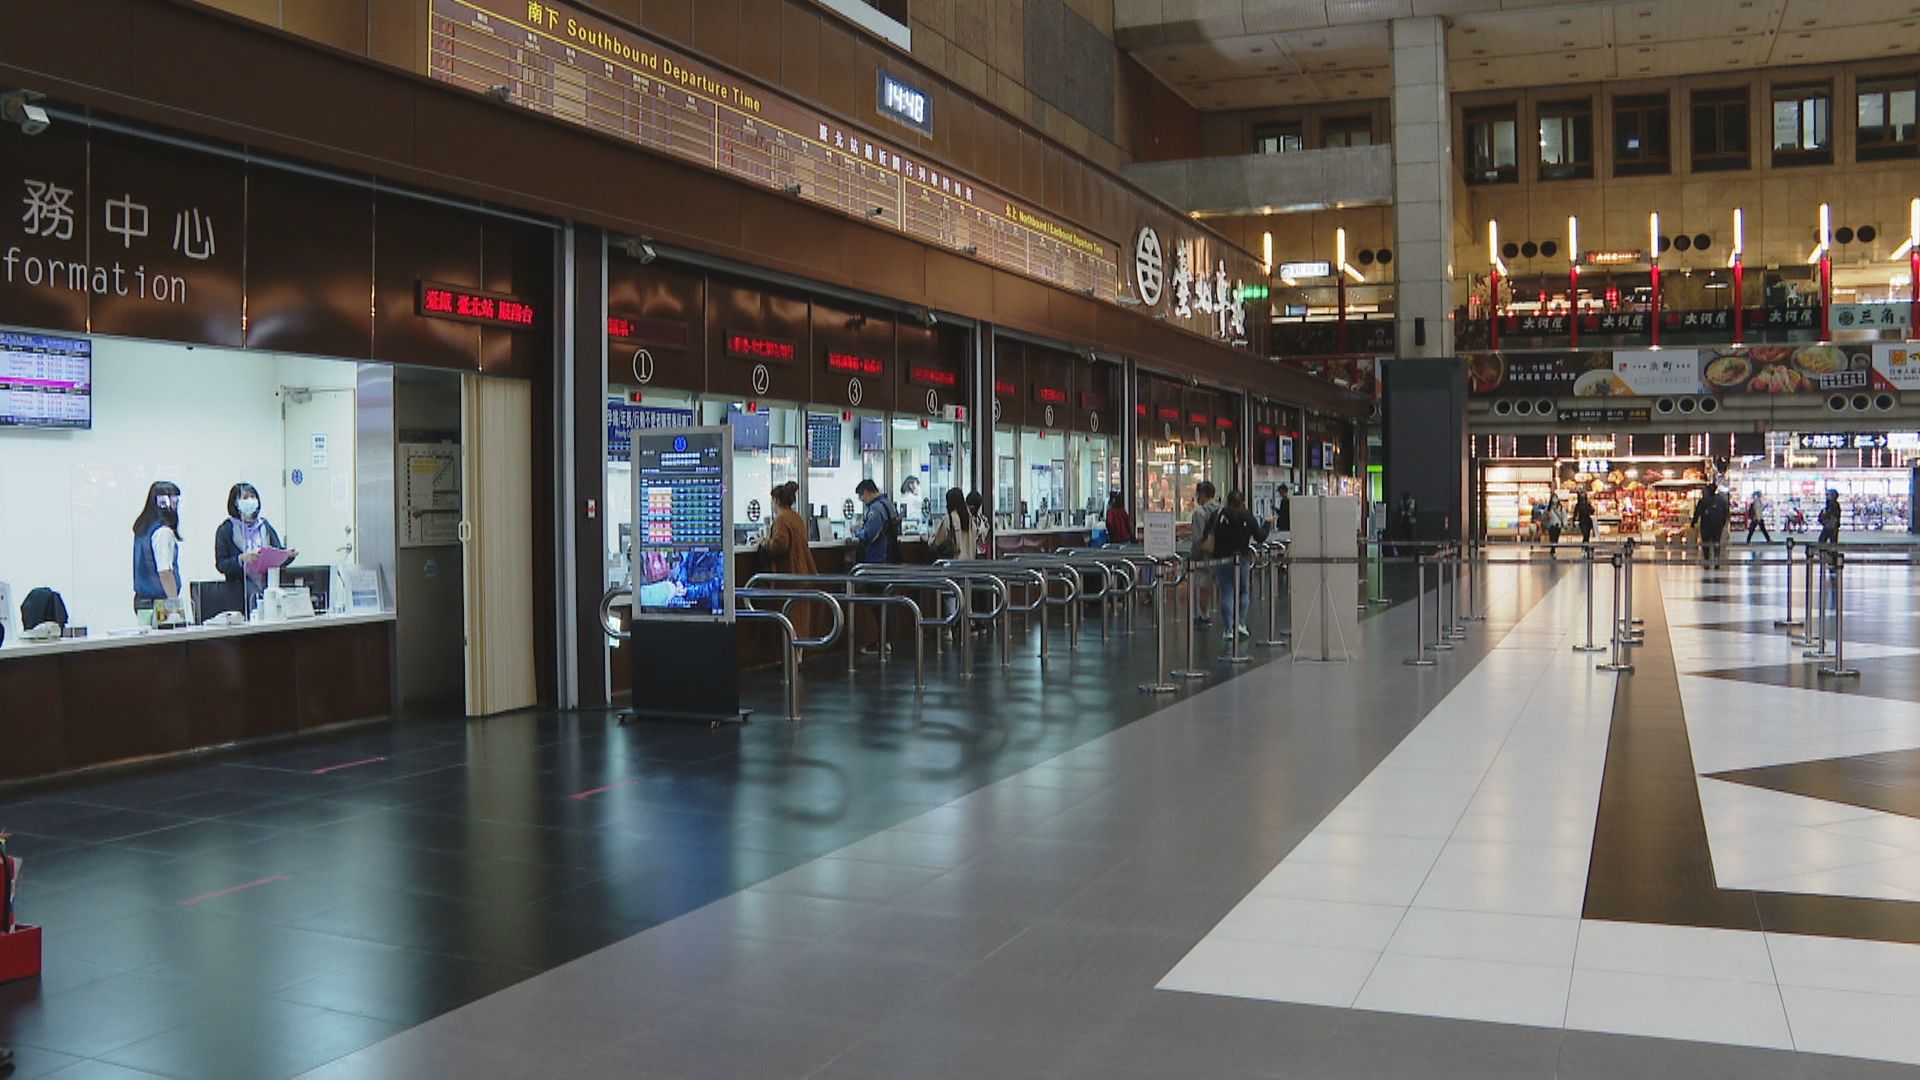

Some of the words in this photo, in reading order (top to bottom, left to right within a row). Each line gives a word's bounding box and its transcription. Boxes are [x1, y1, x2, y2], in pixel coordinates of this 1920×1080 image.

[527, 0, 560, 30] 南下
[567, 18, 659, 72] Southbound
[663, 57, 728, 100] Departure
[731, 86, 762, 113] Time
[886, 80, 926, 124] 14:48
[22, 177, 217, 262] 務中心
[1, 247, 188, 305] formation
